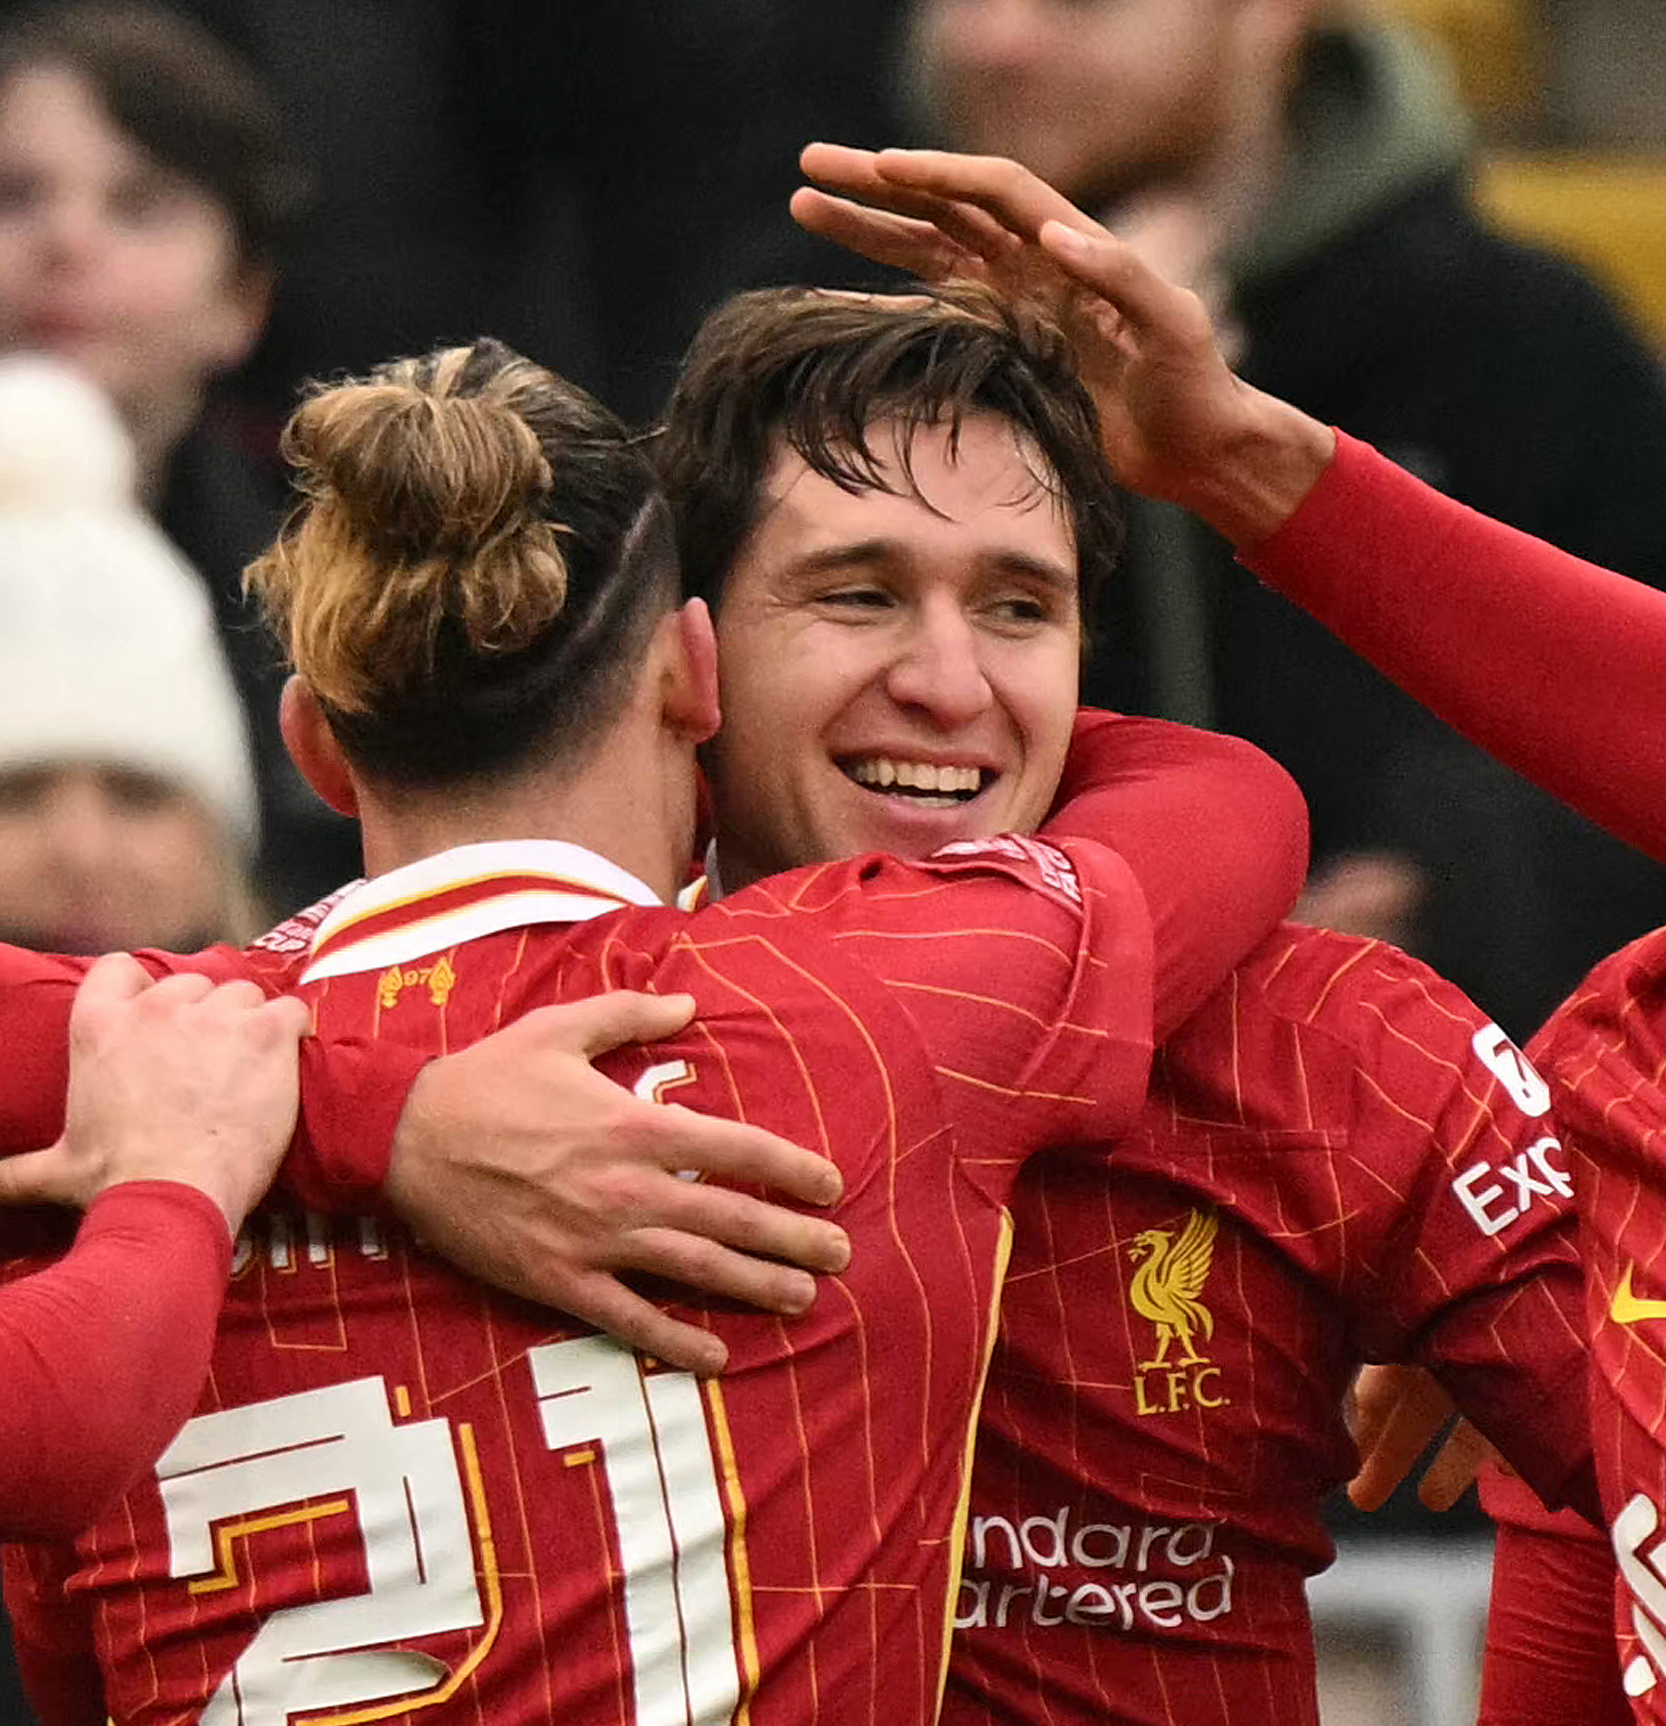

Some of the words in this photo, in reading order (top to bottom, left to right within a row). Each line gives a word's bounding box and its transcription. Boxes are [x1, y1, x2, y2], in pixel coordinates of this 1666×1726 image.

[1134, 1367, 1231, 1415] L.F.C.
[973, 1504, 1229, 1573] ndard
[953, 1555, 1234, 1631] artered
